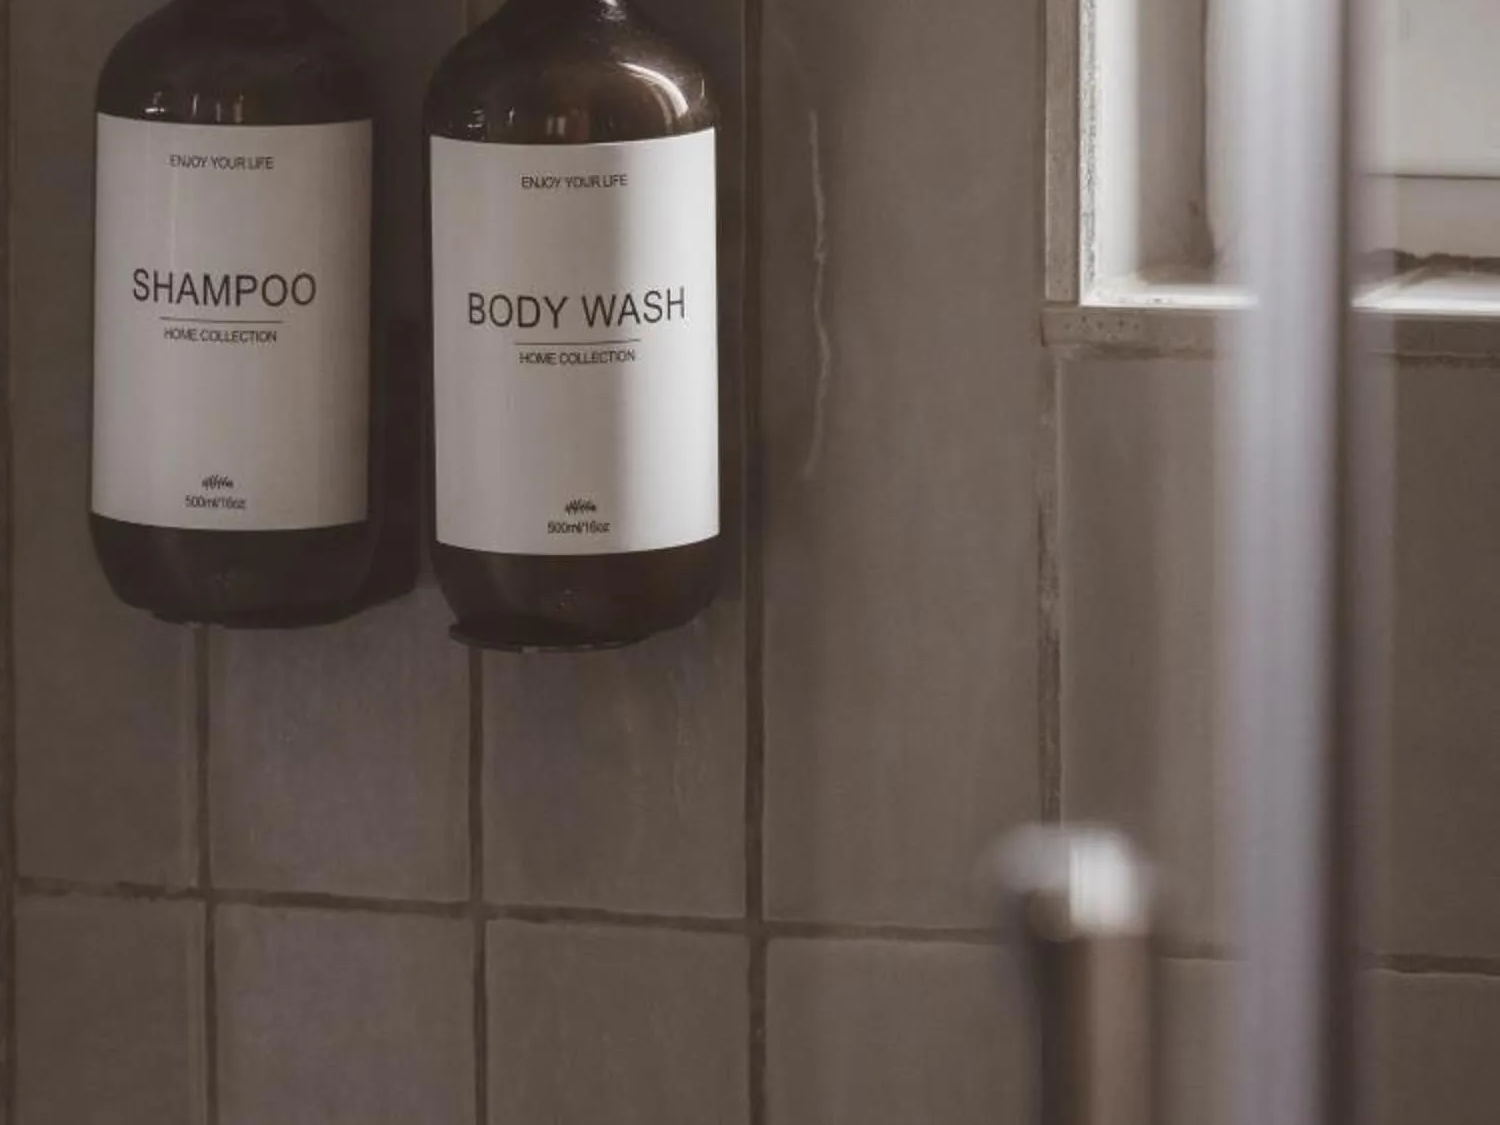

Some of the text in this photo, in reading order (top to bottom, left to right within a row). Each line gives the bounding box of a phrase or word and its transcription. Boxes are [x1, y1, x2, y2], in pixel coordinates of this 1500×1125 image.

[169, 154, 274, 170] ENJOY YOUR LIFE
[521, 174, 628, 189] ENJOY YOUR LIFE
[132, 268, 317, 307] SHAMPOO
[467, 285, 686, 329] BODY WASH
[163, 327, 277, 343] HOME COLLECTION
[519, 350, 636, 365] HOME COLLECTION
